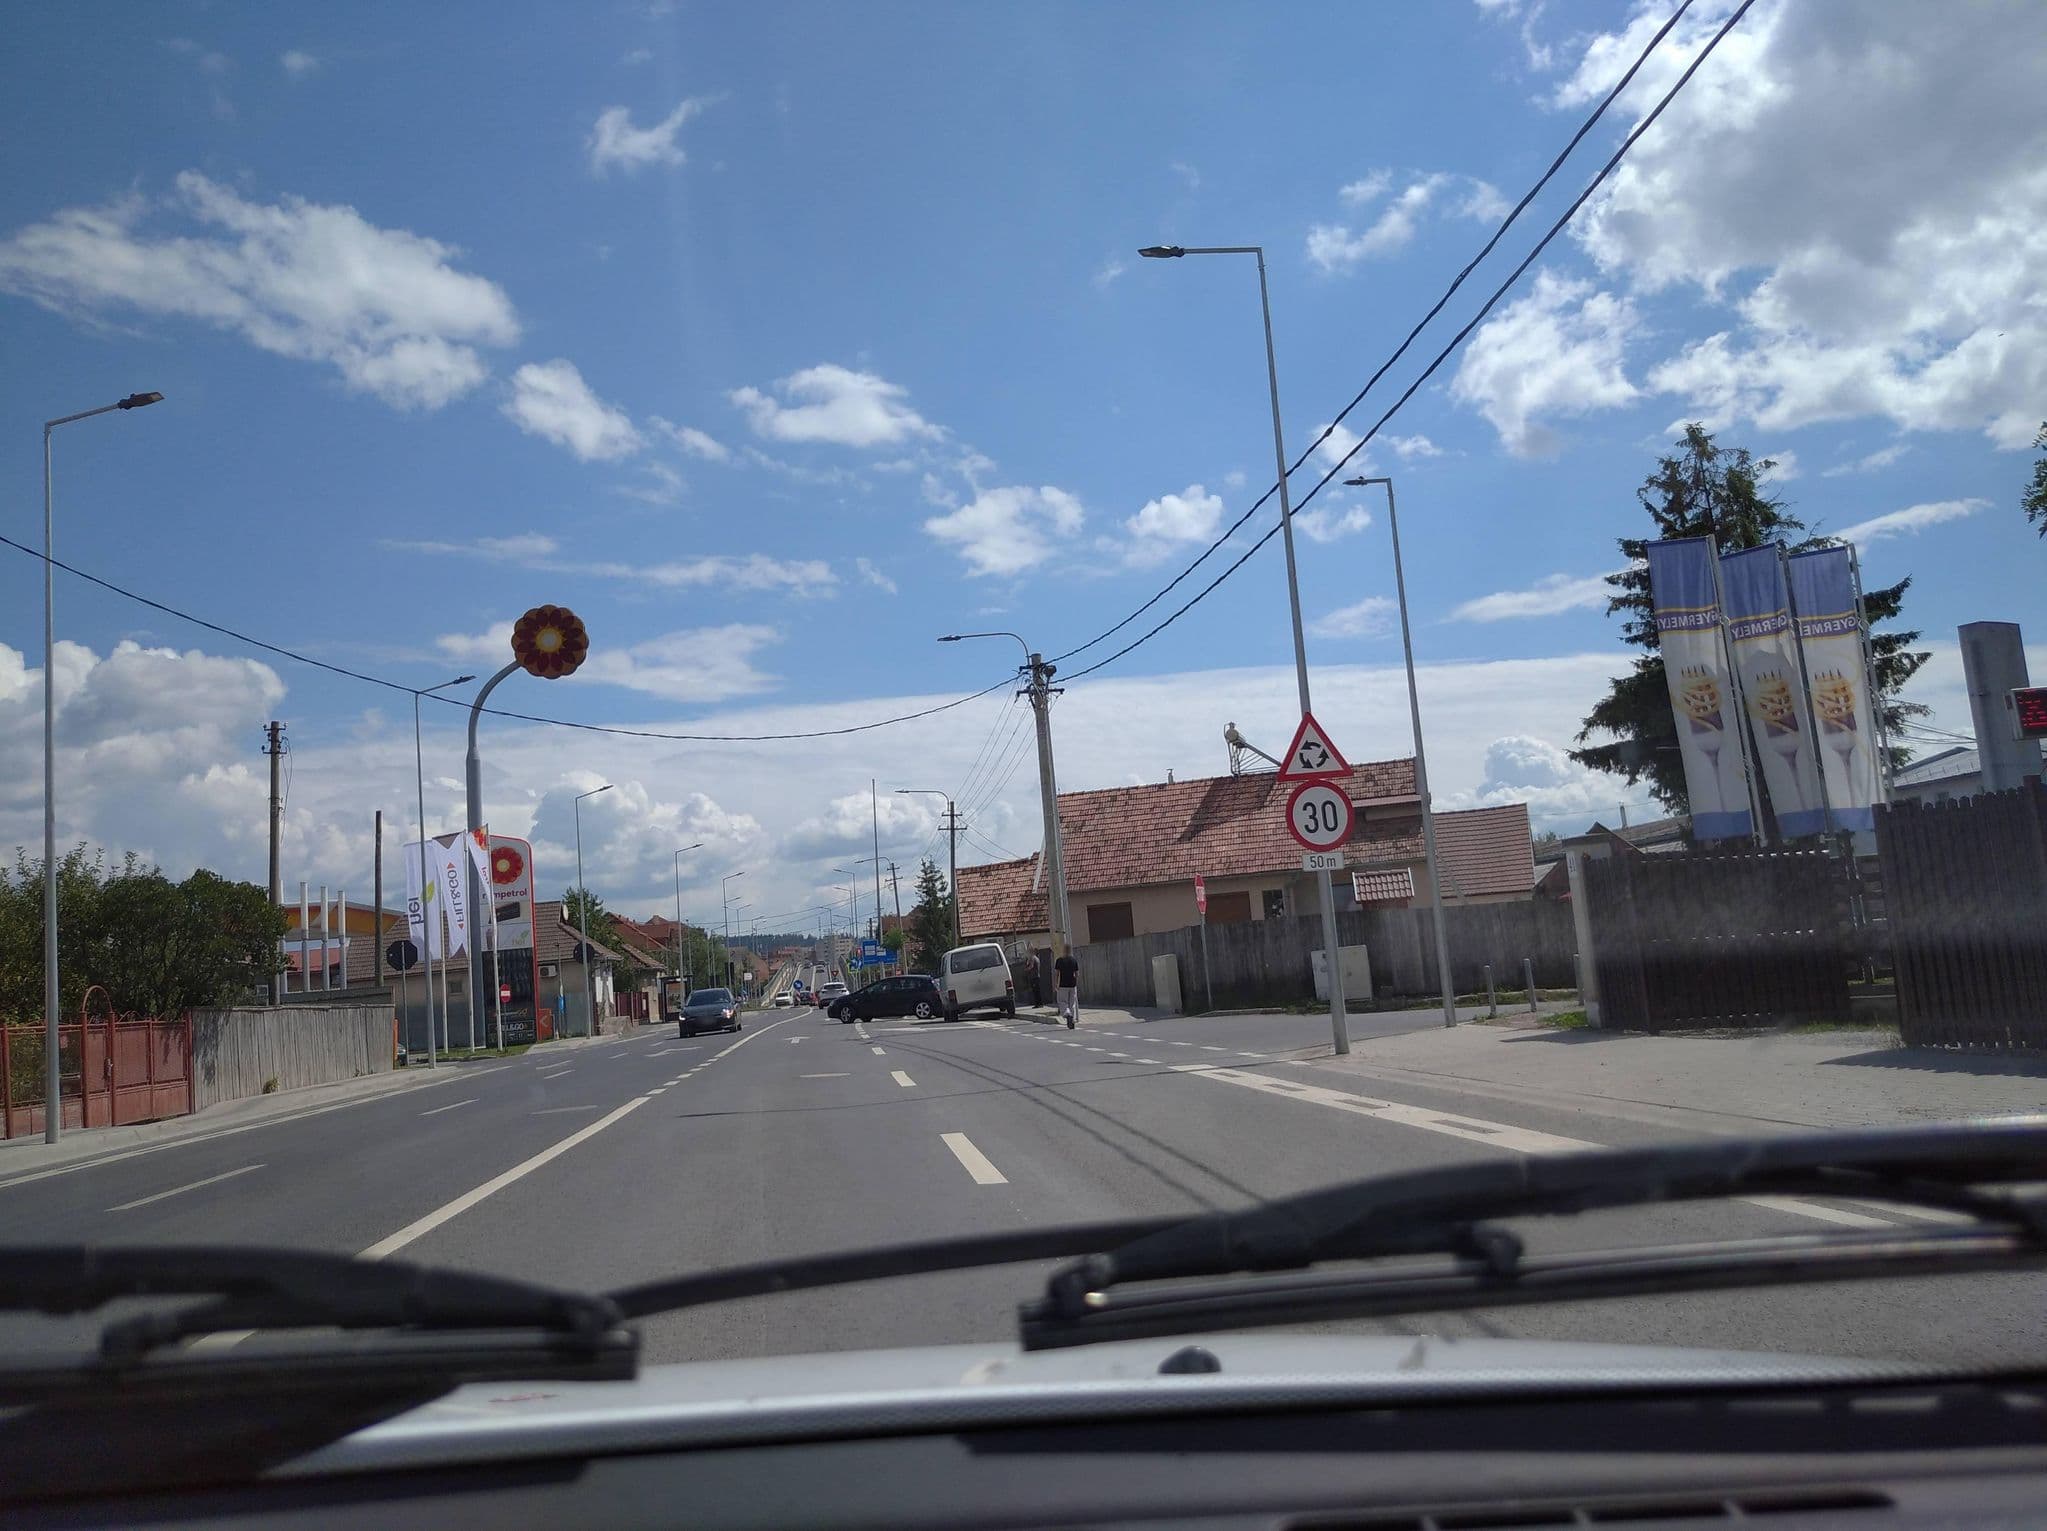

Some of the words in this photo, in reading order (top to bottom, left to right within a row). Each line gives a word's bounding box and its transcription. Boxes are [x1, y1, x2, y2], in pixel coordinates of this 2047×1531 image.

[1302, 800, 1338, 834] 30
[1310, 855, 1324, 869] 50
[1327, 857, 1336, 868] m
[448, 869, 465, 923] FILL&GO
[482, 888, 528, 900] rmpetrol
